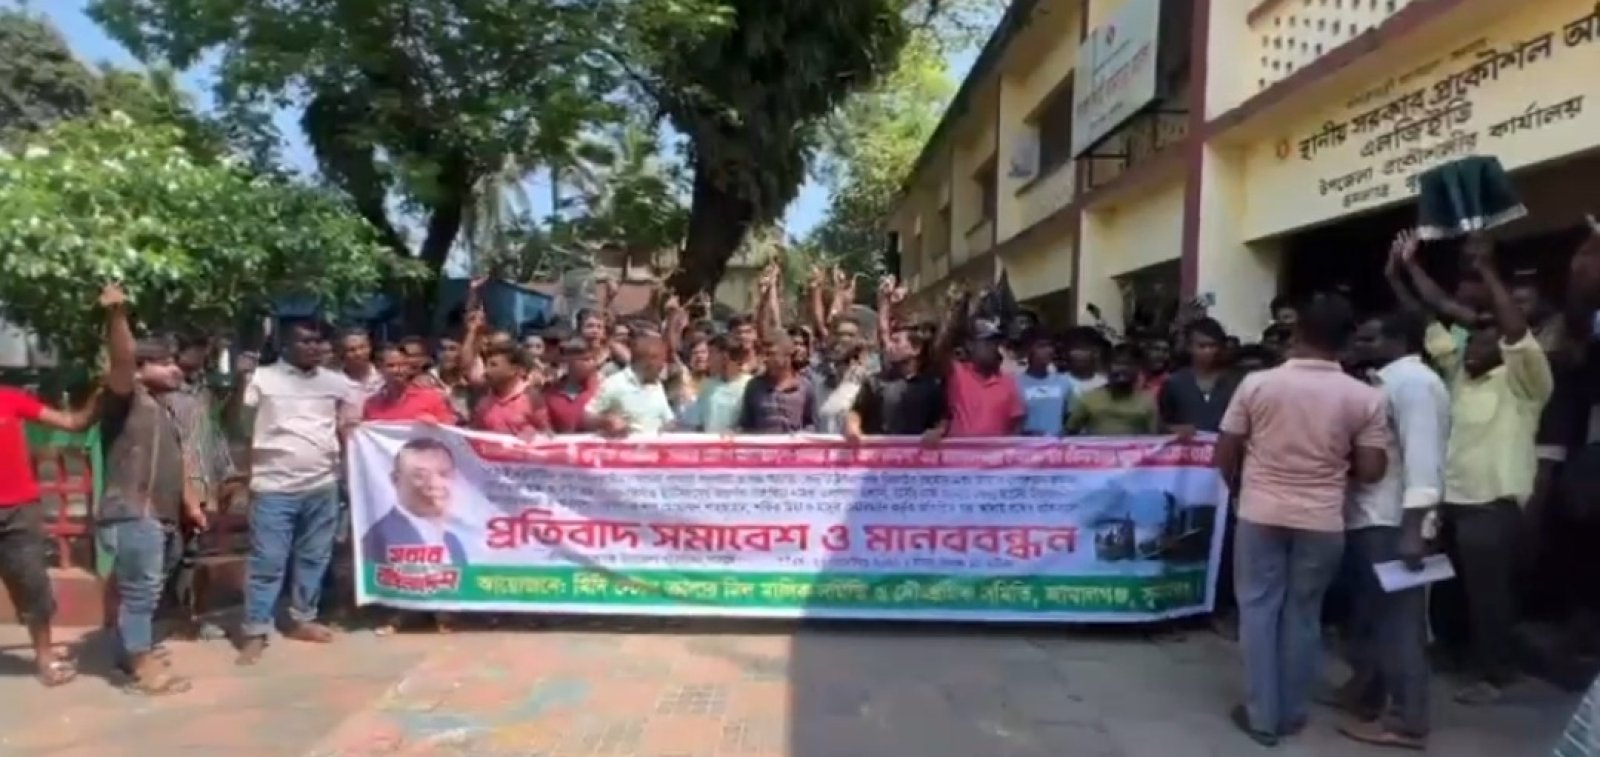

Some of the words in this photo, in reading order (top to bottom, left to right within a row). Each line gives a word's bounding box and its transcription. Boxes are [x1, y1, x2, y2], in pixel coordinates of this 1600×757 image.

[1298, 117, 1348, 161] স্থানীয়
[1351, 86, 1426, 137] সরকার
[1429, 31, 1554, 107] প্রকৌশল
[1318, 165, 1373, 197] উপজেলা
[1384, 128, 1479, 177] প্রকৌশলীর
[1488, 95, 1585, 139] কার্যালয়
[1359, 98, 1474, 159] এলজিইডি
[388, 545, 444, 564] সবার
[486, 509, 641, 550] প্রতিবাদ
[650, 523, 810, 551] সমাবেশ
[822, 526, 851, 551] ও
[863, 524, 1078, 560] মানববন্ধন
[760, 577, 812, 600] মালিক
